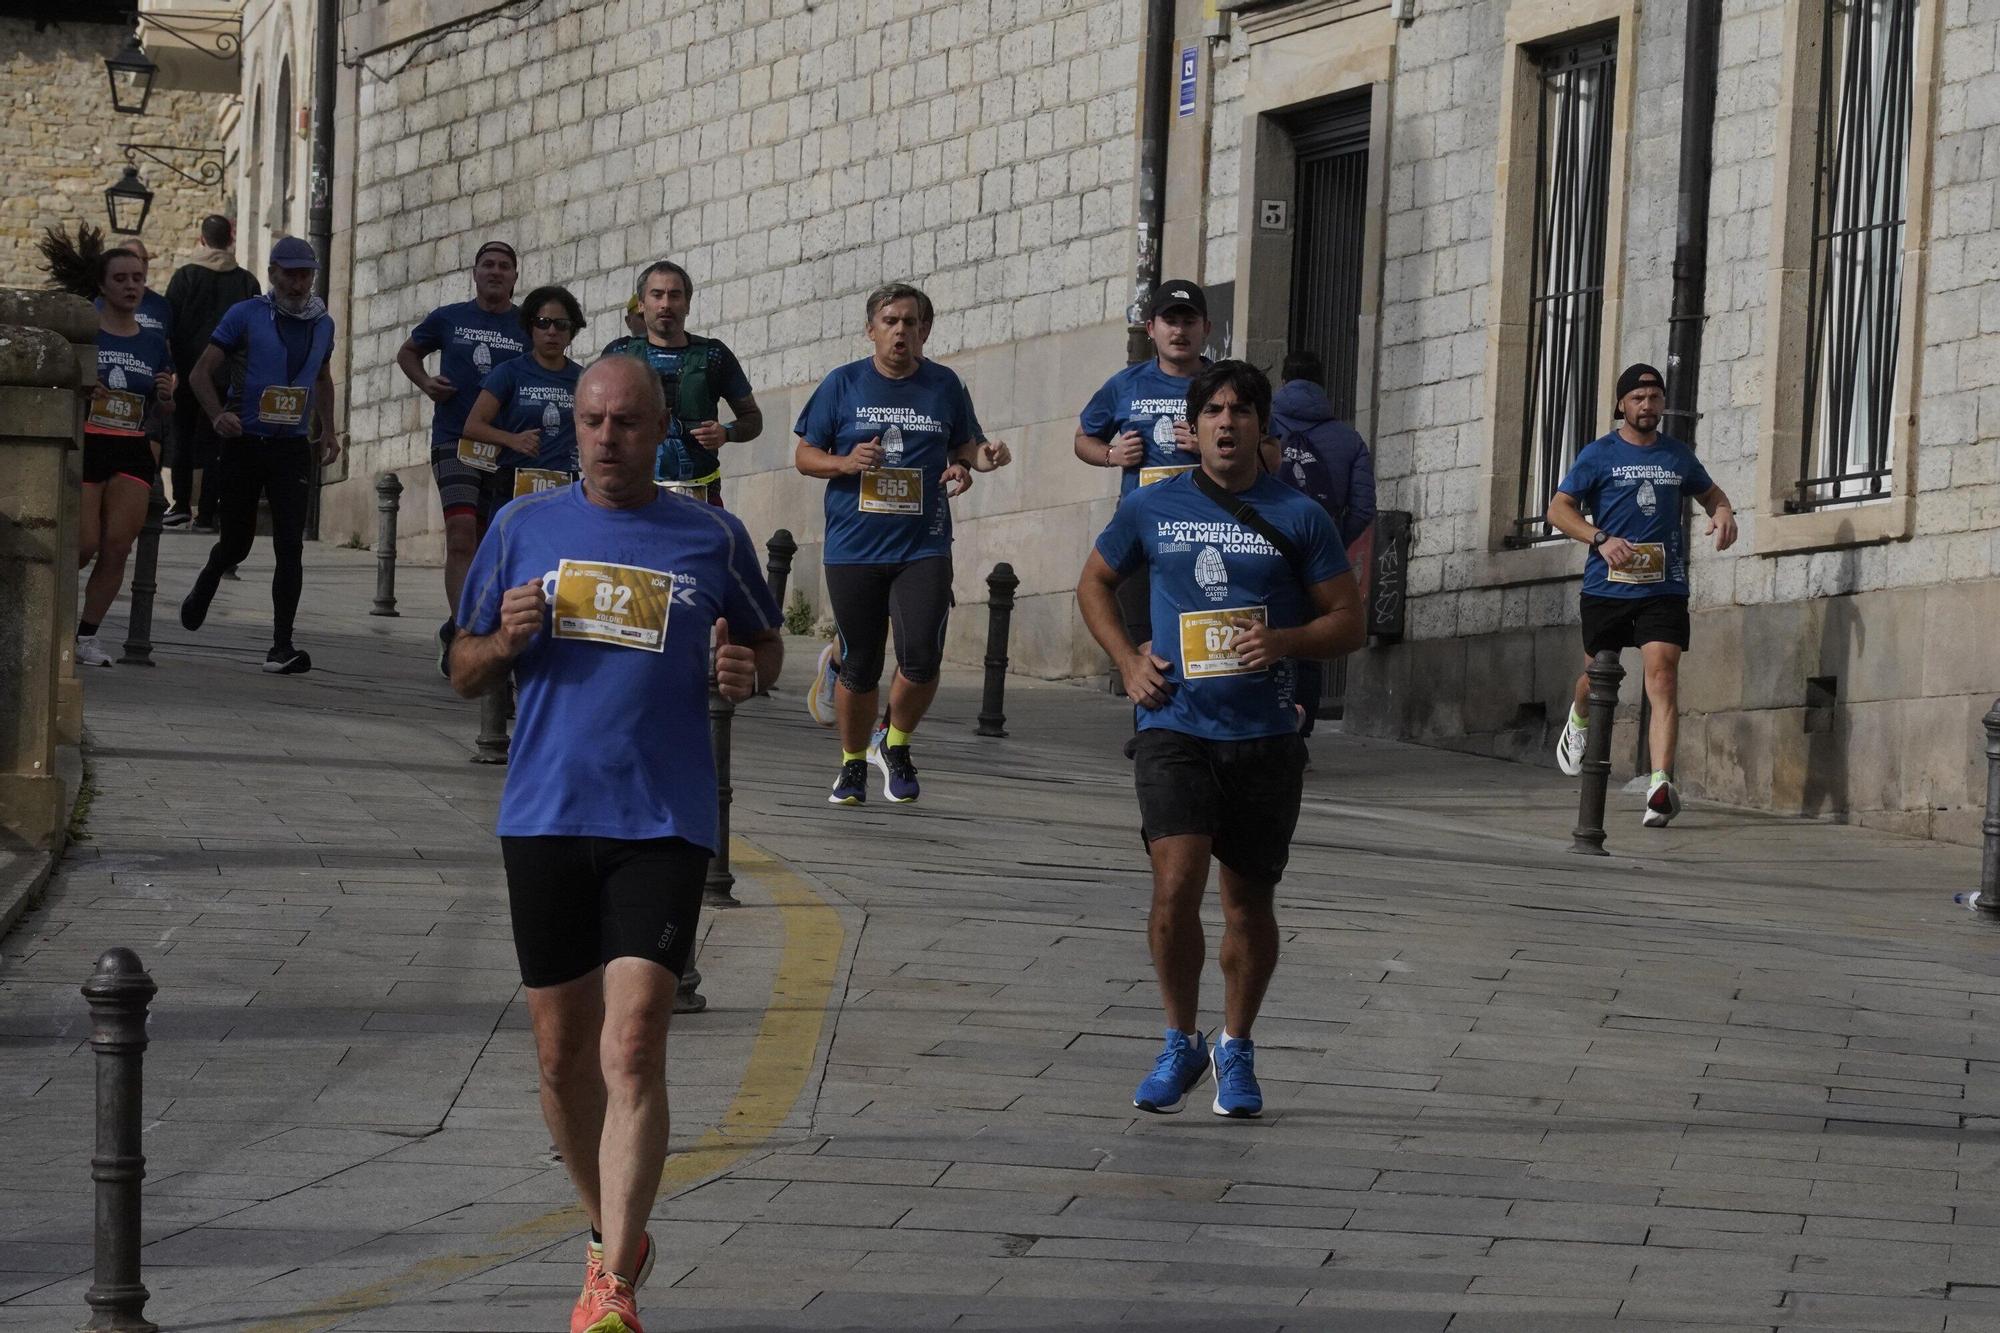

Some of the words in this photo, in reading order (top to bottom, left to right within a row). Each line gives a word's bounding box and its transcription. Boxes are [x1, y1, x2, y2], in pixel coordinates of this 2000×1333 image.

[1266, 204, 1281, 225] 5
[463, 328, 502, 337] CONQUISTA
[463, 333, 515, 345] ALMENDRA
[528, 387, 568, 395] CONQUISTA
[106, 400, 131, 416] 453
[274, 395, 297, 411] 123
[856, 406, 866, 414] LA
[867, 407, 915, 415] CONQUISTA
[869, 413, 933, 424] ALMENDRA
[903, 424, 942, 432] KONKISTA
[473, 442, 496, 458] 570
[1625, 471, 1676, 479] ALMENDRA
[877, 479, 908, 496] 555
[1157, 521, 1171, 532] LA
[1171, 521, 1241, 533] CONQUISTA
[1173, 530, 1267, 545] ALMENDRA
[1223, 544, 1283, 556] KONKISTA
[594, 582, 631, 614] 82
[657, 921, 674, 949] GORE
